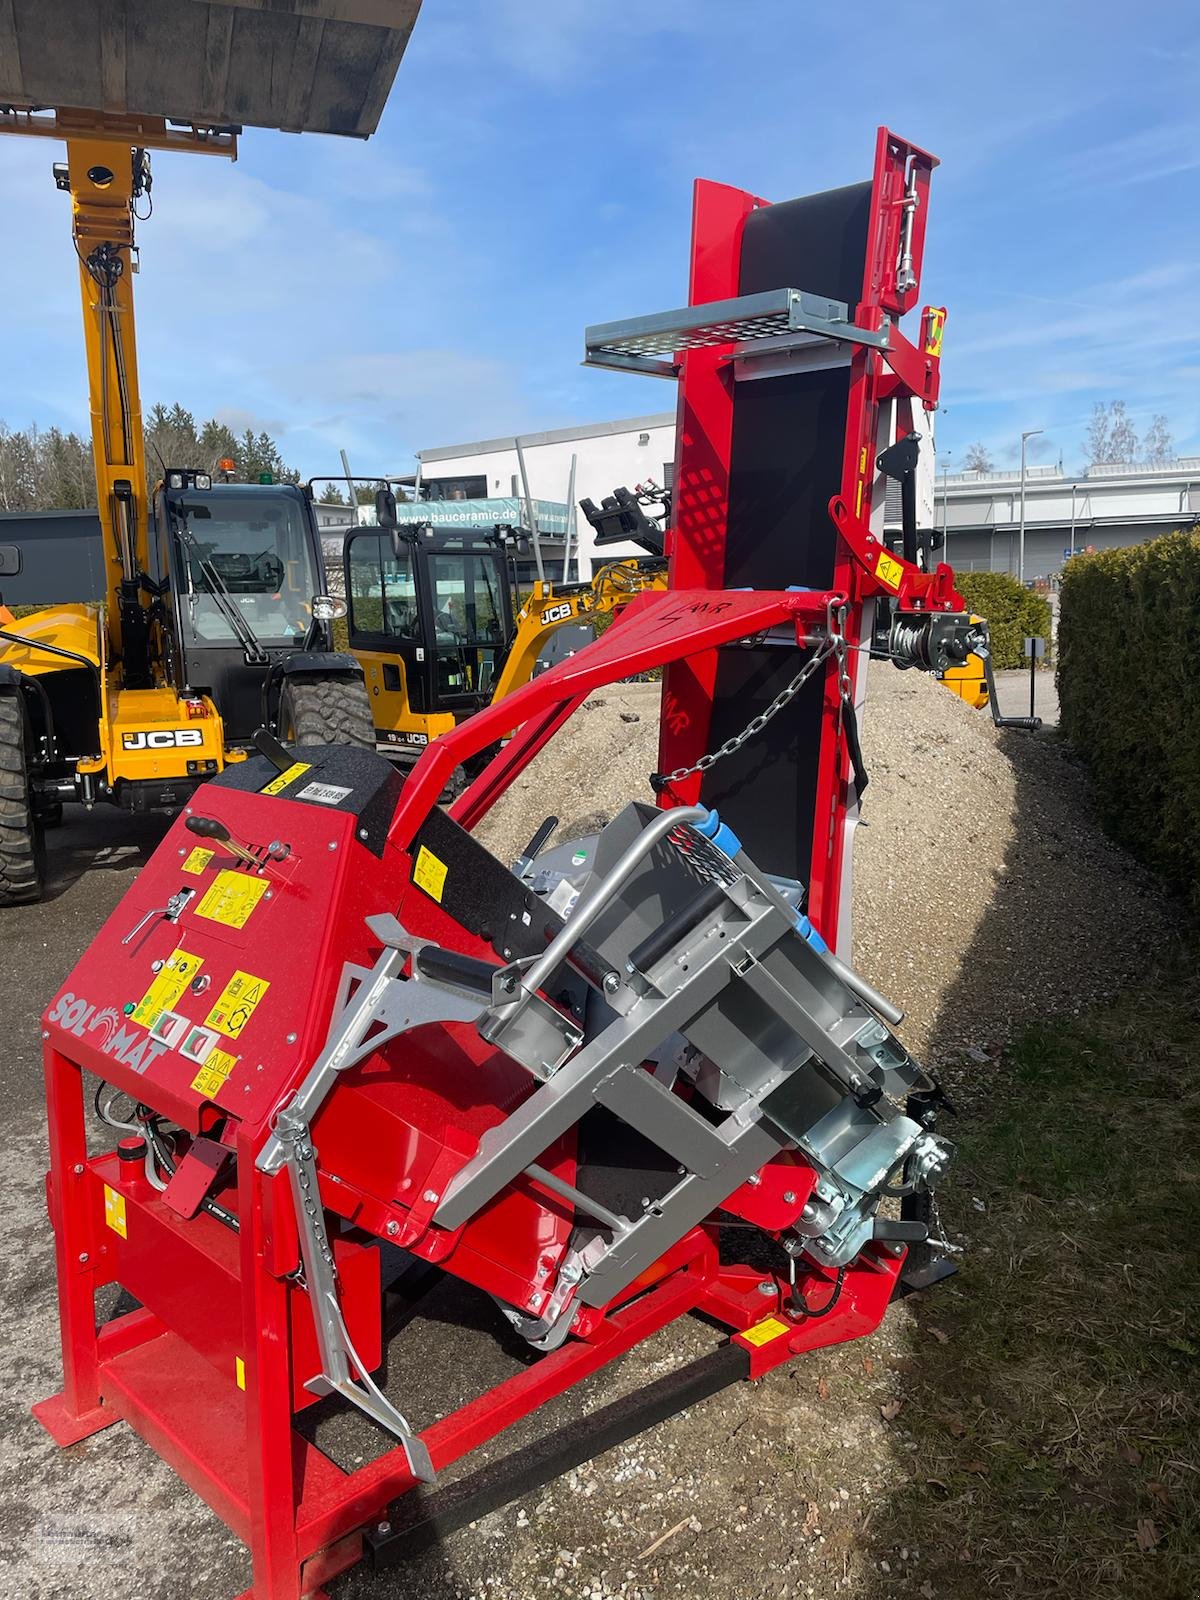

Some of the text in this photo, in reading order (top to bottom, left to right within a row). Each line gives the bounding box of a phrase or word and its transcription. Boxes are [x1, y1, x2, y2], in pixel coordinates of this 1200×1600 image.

[398, 509, 517, 525] www.bauceramic.de
[541, 603, 572, 625] JCB
[123, 729, 203, 750] JCB
[406, 733, 428, 745] JCB
